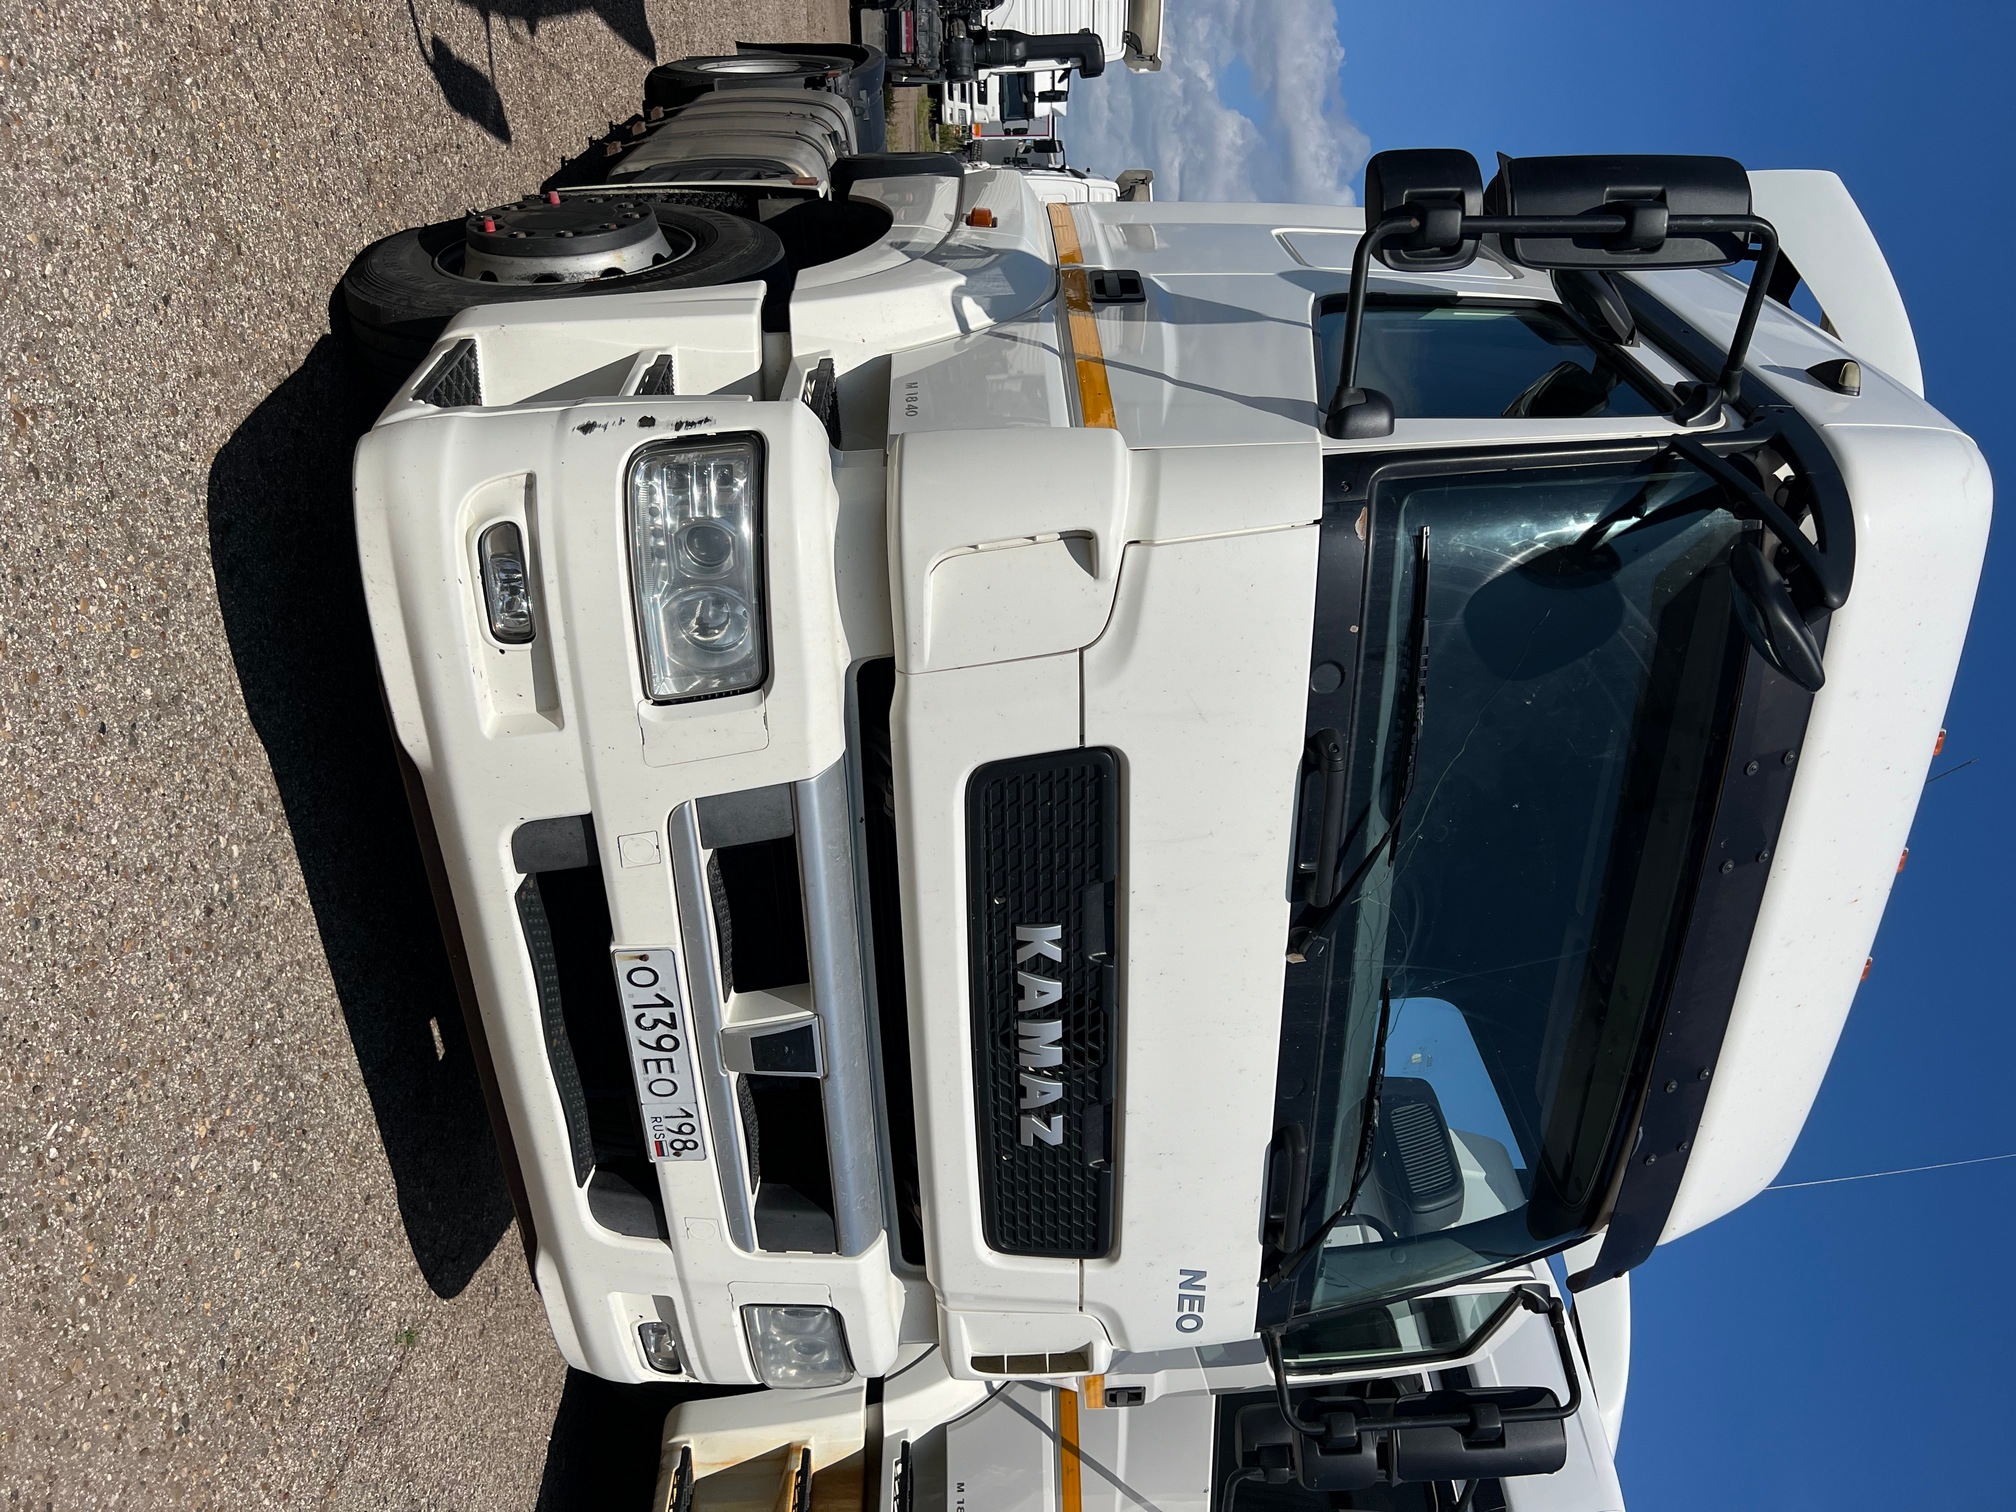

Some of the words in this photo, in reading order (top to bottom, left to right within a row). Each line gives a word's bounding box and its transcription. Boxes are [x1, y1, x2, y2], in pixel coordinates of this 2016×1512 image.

[905, 382, 919, 390] M
[905, 391, 919, 417] 1840
[1016, 923, 1064, 1148] KAMAZ
[650, 1116, 665, 1140] RUS
[664, 1107, 700, 1151] 198
[1175, 1268, 1208, 1334] NEO
[956, 1482, 965, 1493] M
